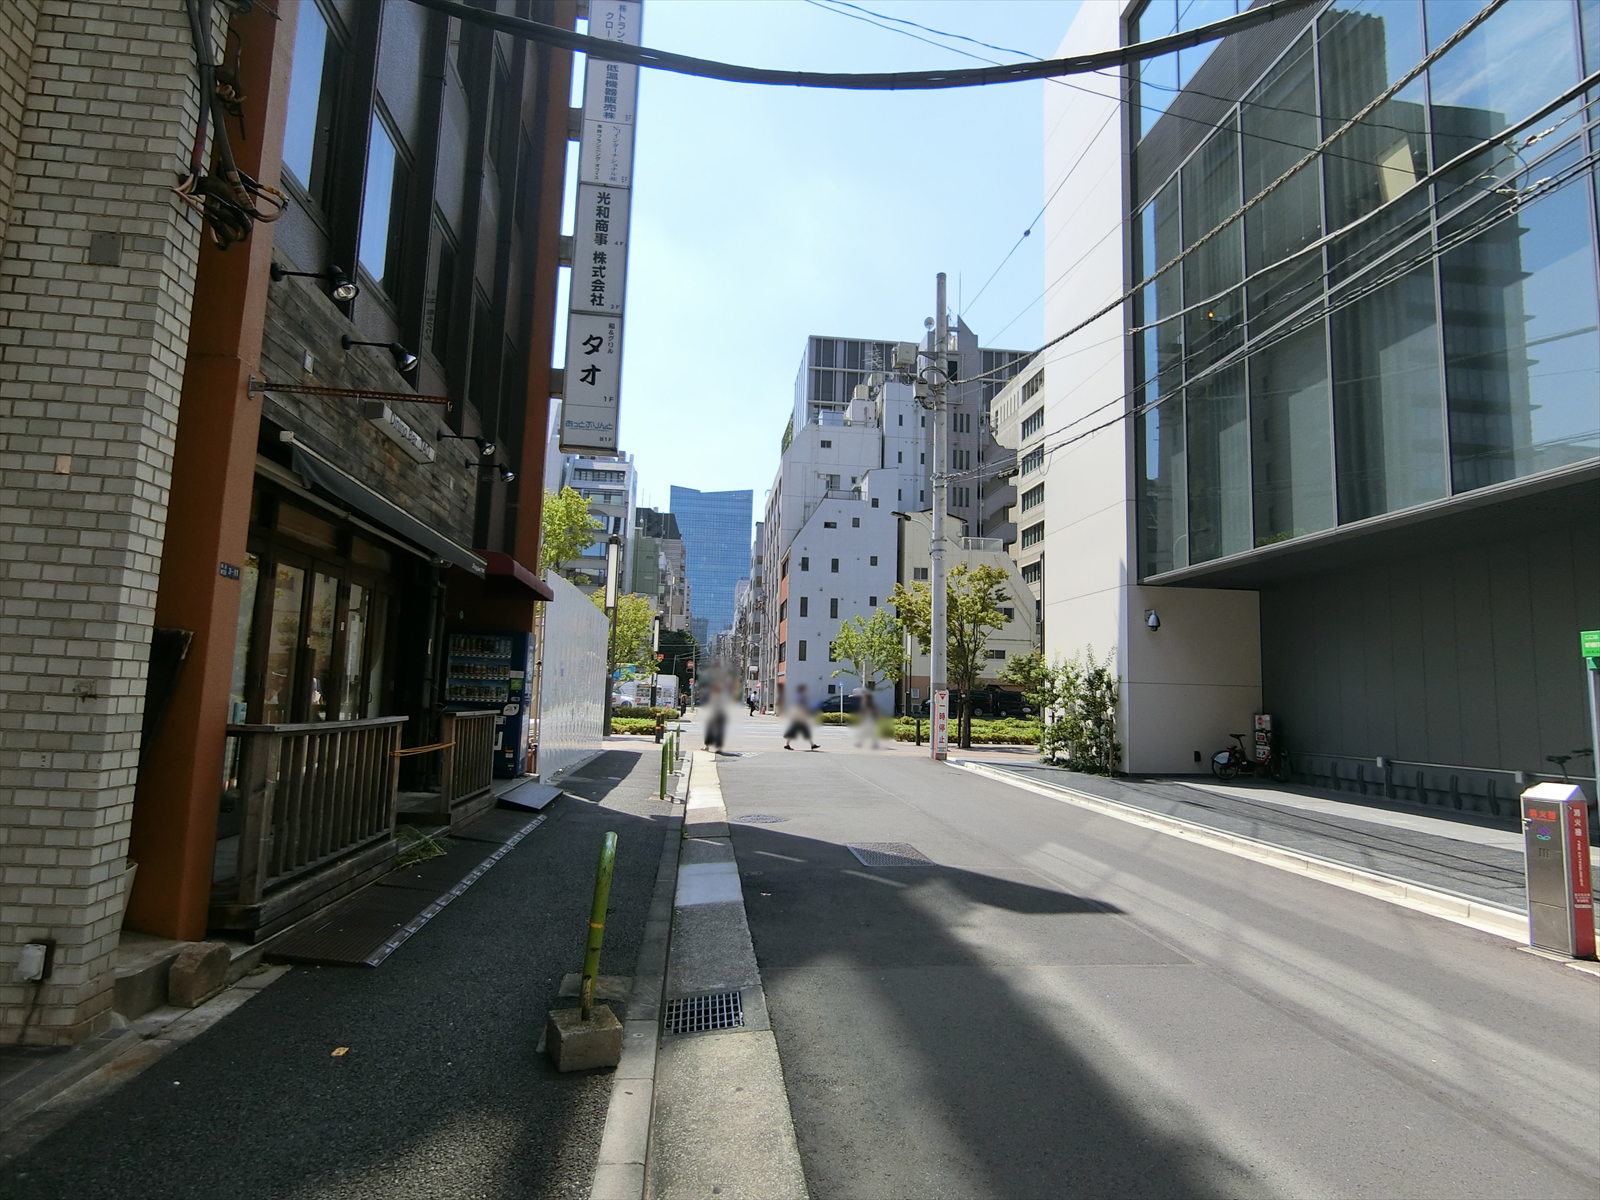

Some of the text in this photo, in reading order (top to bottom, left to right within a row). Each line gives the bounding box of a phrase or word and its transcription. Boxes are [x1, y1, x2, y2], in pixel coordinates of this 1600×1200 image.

[590, 192, 611, 306] 光和商事 株式会社
[579, 334, 603, 386] タオ
[565, 420, 613, 430] あっとぷりんと
[938, 704, 946, 744] 一時停止
[1529, 808, 1556, 819] 消火器
[1573, 808, 1582, 836] 消火器
